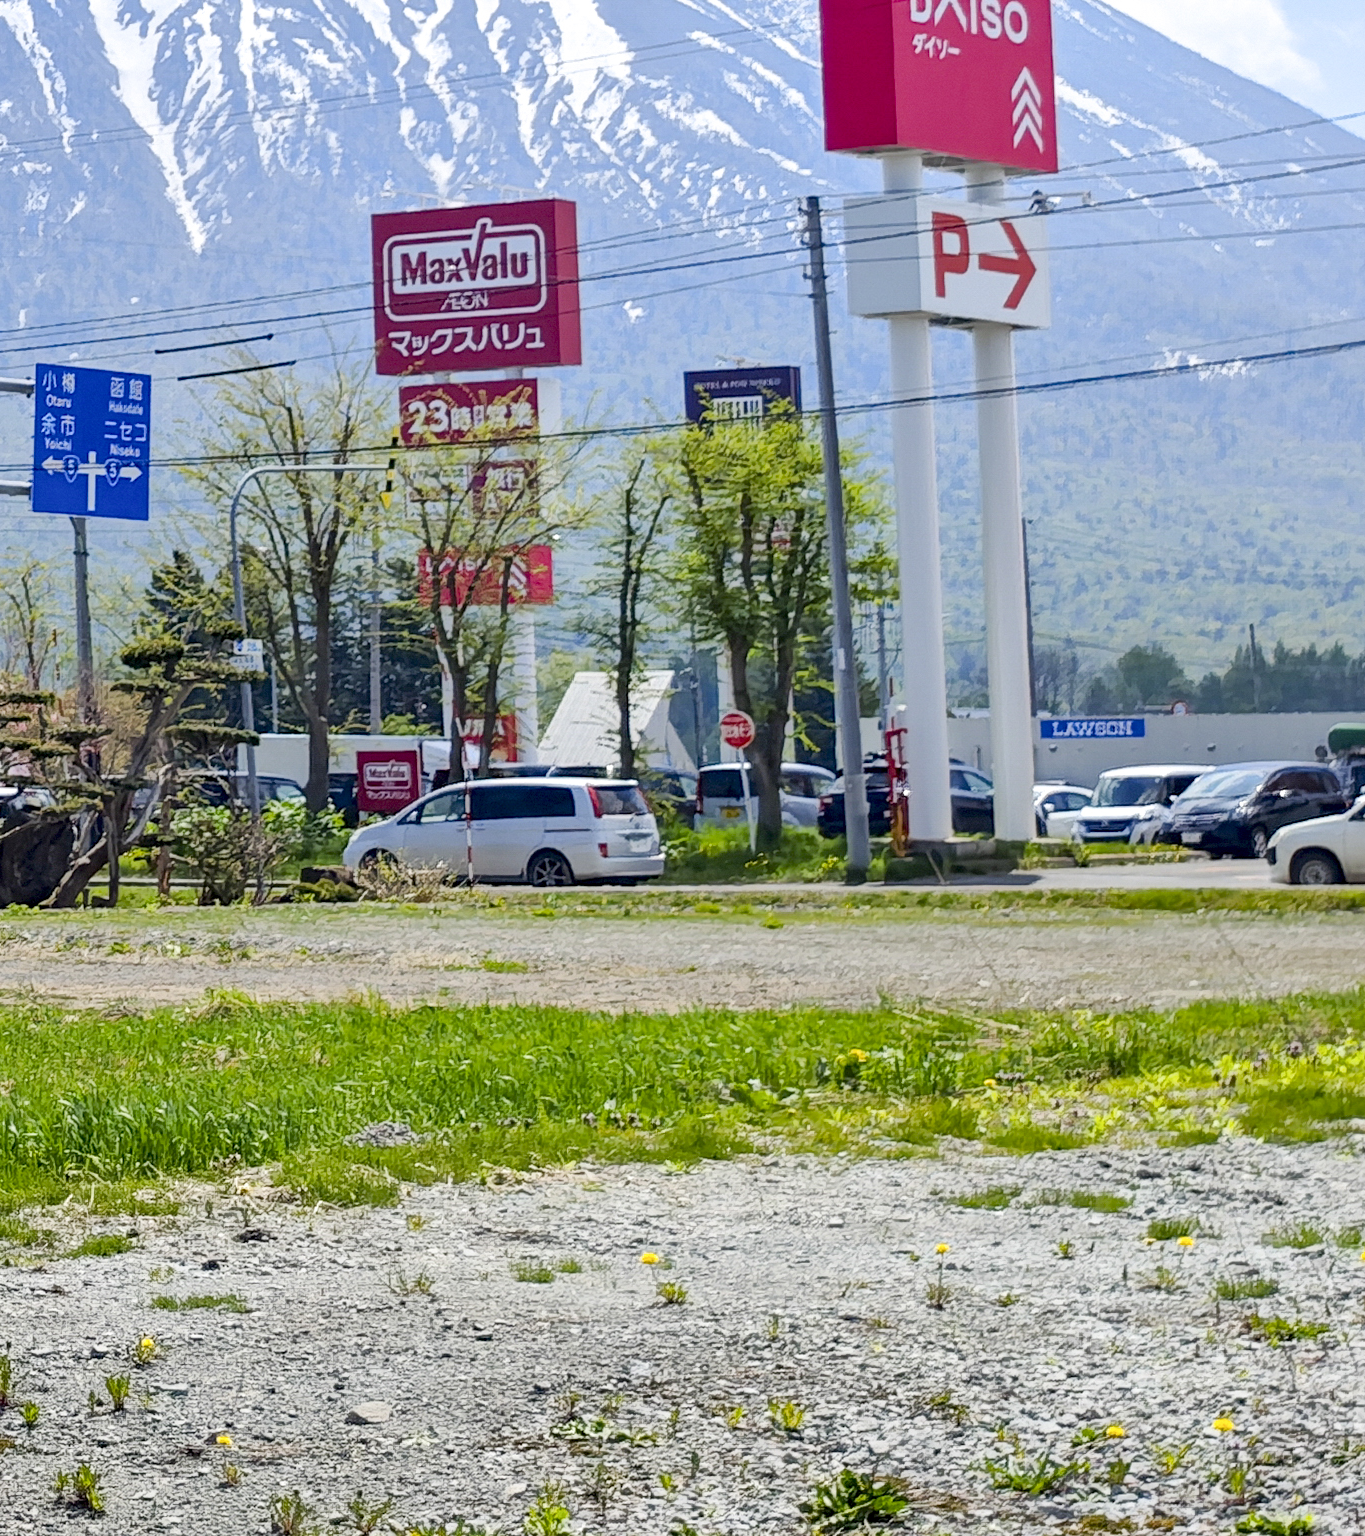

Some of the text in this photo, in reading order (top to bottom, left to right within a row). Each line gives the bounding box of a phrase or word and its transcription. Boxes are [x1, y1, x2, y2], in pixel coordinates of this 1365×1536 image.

[911, 33, 961, 59] ダイソー
[400, 222, 529, 287] MaxValu
[931, 210, 970, 298] P
[388, 322, 546, 358] マックスバリュ
[42, 370, 76, 394] 小樽
[41, 412, 76, 437] 余市
[103, 421, 148, 442] ニセコ
[1052, 720, 1134, 736] LAWSON
